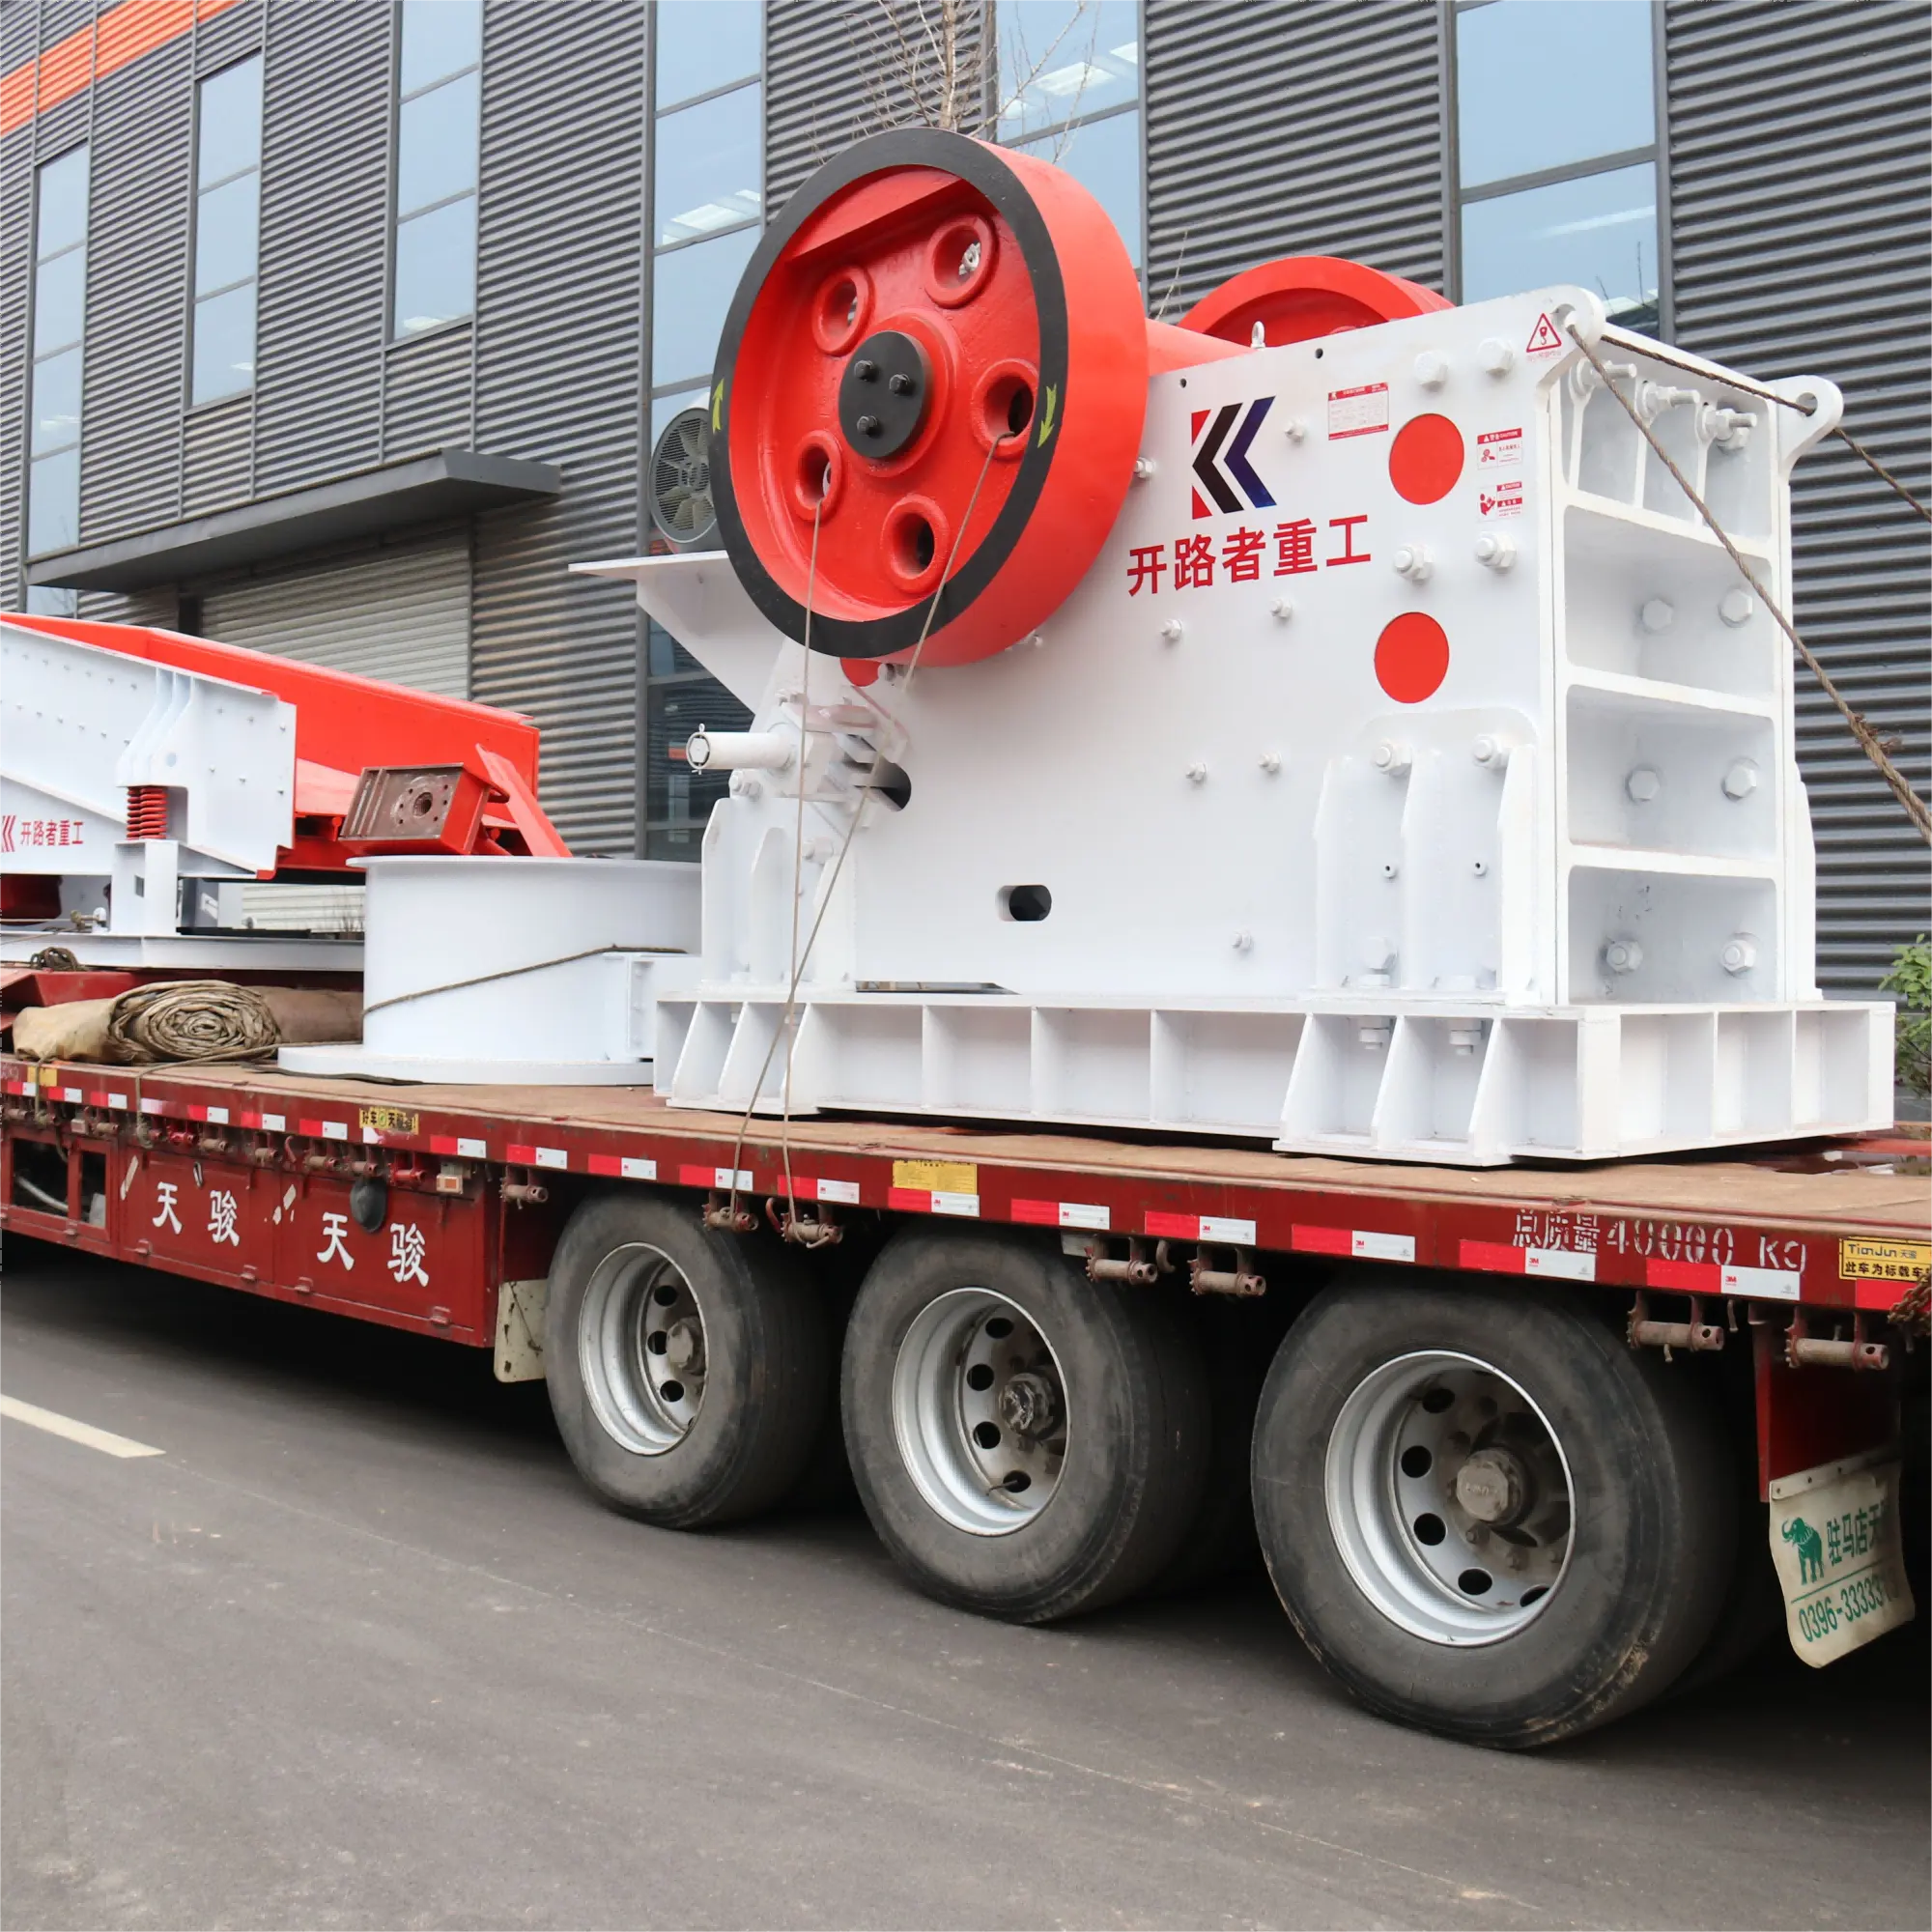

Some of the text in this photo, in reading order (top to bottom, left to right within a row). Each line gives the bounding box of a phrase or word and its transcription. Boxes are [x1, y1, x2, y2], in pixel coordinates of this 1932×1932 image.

[1126, 514, 1372, 597] 开路者重工
[20, 819, 84, 846] 开路者重工
[153, 1181, 241, 1247] 天骏
[316, 1211, 430, 1288] 天骏
[1848, 1243, 1897, 1257] TianJun
[1827, 1500, 1890, 1567] 驻马店天
